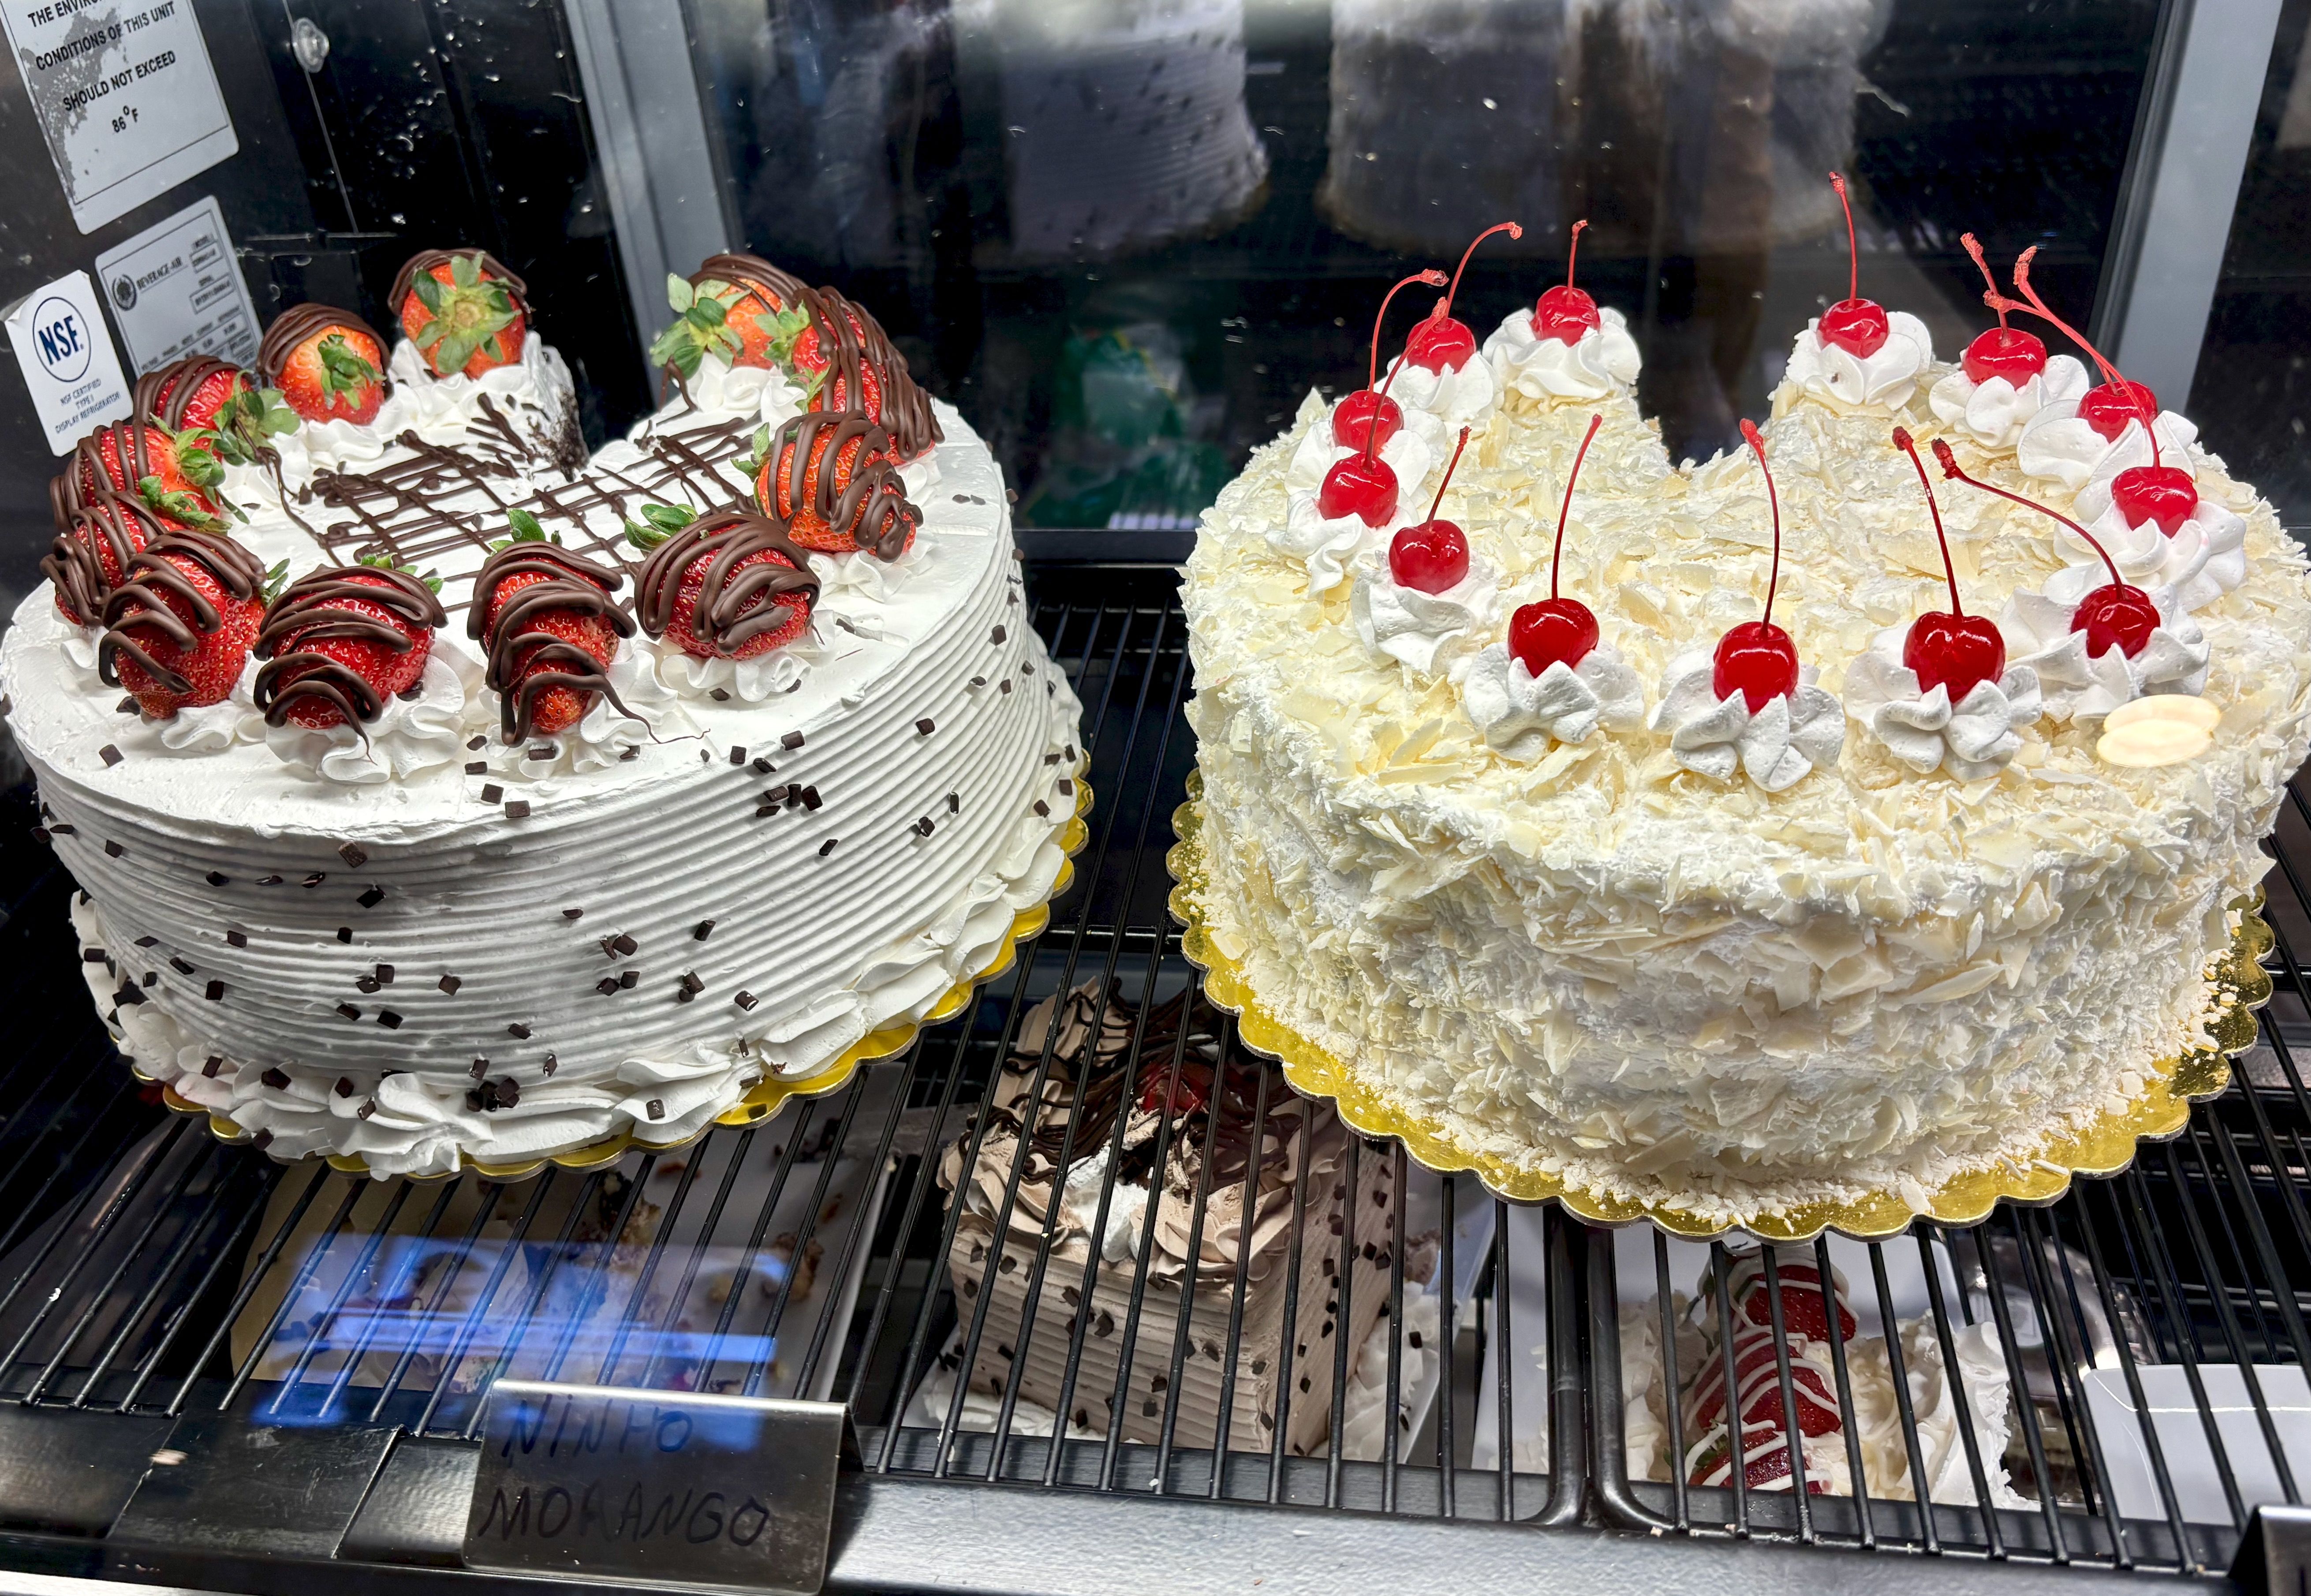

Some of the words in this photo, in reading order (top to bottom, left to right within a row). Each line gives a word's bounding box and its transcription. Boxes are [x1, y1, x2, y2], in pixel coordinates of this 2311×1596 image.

[27, 6, 54, 27] THE
[55, 0, 102, 17] ENVI
[36, 31, 106, 71] CONDITIONS
[108, 24, 123, 40] OF
[124, 13, 149, 33] THIS
[151, 1, 175, 22] UNIT
[63, 81, 109, 111] SHOULD
[110, 69, 133, 90] NOT
[135, 50, 176, 79] EXCEED
[38, 315, 80, 365] NSF
[477, 1478, 771, 1548] MORANGO
